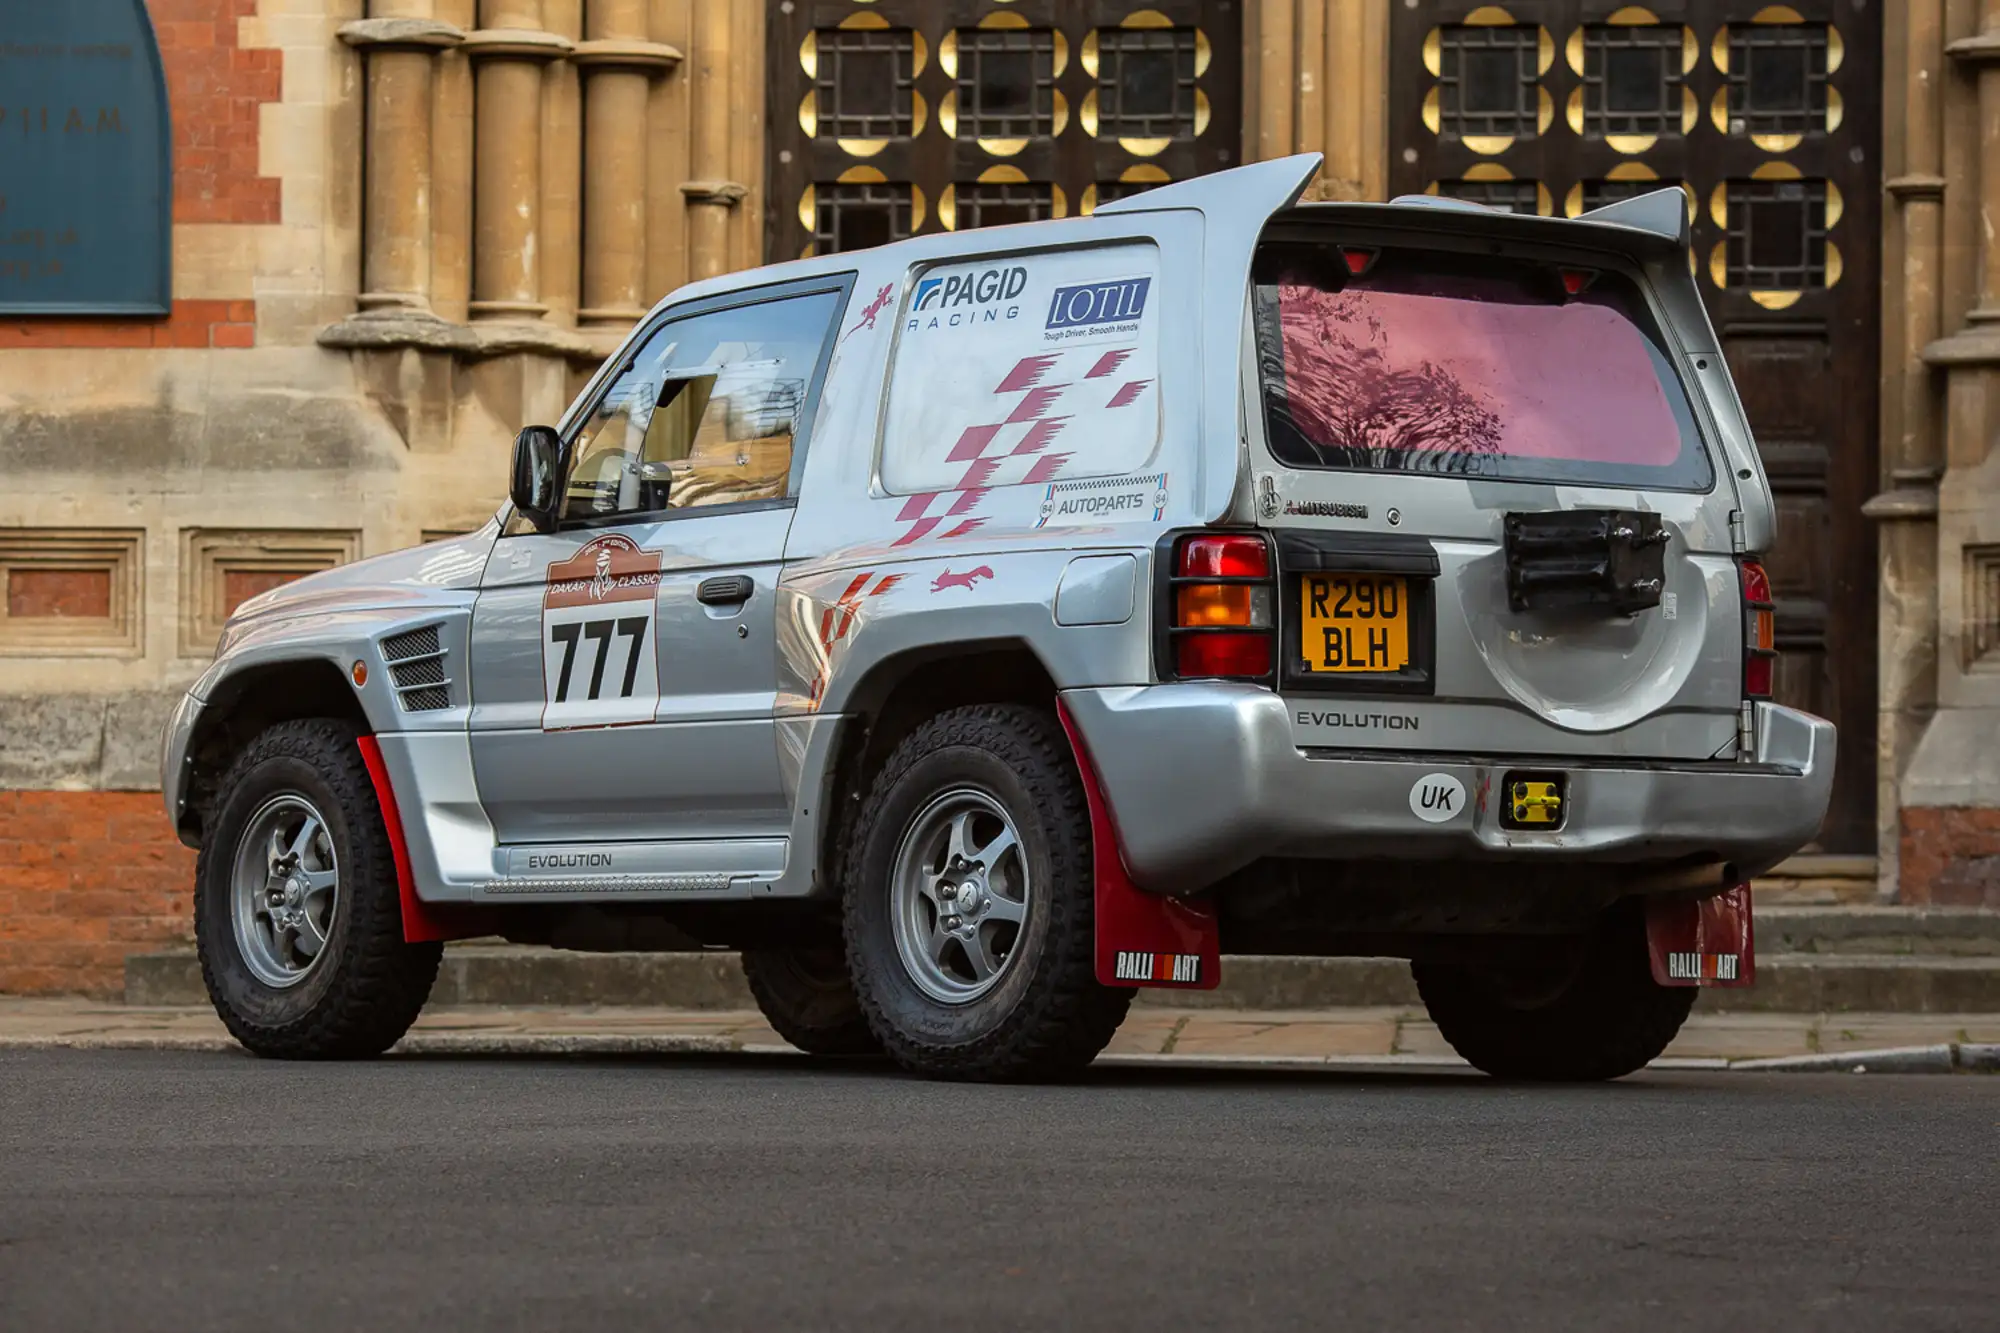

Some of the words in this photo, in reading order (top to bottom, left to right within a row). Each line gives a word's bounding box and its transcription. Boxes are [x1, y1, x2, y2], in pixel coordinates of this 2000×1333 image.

[940, 267, 1027, 308] PAGID
[1050, 281, 1143, 326] LOTIL
[907, 307, 1019, 332] RACING
[1043, 331, 1065, 342] Tough
[1064, 328, 1087, 339] Driver,
[1088, 325, 1116, 337] Smooth
[1115, 321, 1140, 334] Hands
[1058, 493, 1144, 515] AUTOPARTS
[1299, 501, 1369, 520] MITSUBISHI
[550, 582, 586, 594] DAKAR
[618, 574, 658, 588] CLASSIC
[1310, 579, 1398, 618] R290
[551, 615, 650, 704] 777
[1323, 627, 1389, 667] BLH
[1297, 711, 1419, 730] EVOLUTION
[1420, 785, 1456, 810] UK
[529, 854, 611, 868] EVOLUTION
[1116, 951, 1154, 980] RALLI
[1172, 954, 1199, 981] ART
[1669, 953, 1701, 978] RALLI
[1717, 954, 1738, 979] ART
